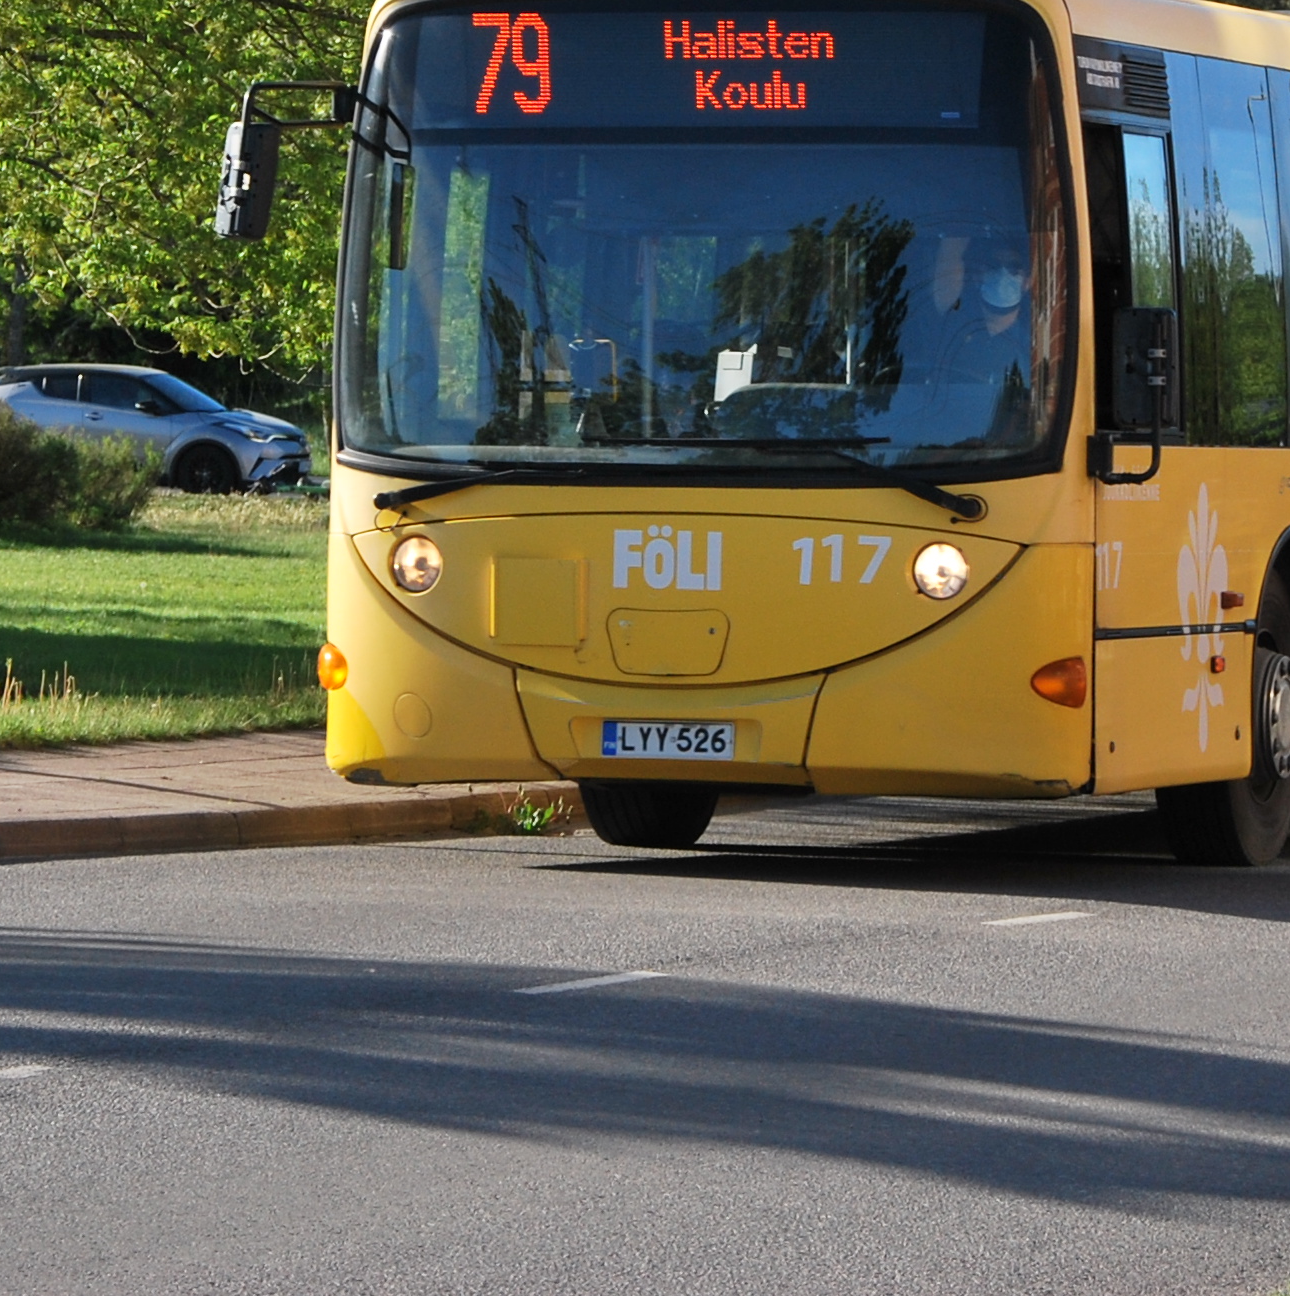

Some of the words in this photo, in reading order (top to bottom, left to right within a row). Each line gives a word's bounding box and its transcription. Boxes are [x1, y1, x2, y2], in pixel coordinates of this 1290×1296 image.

[472, 12, 552, 115] 79
[663, 20, 835, 59] Halisten
[695, 70, 807, 109] Koulu
[612, 524, 722, 591] FÖLI
[792, 534, 892, 585] 117
